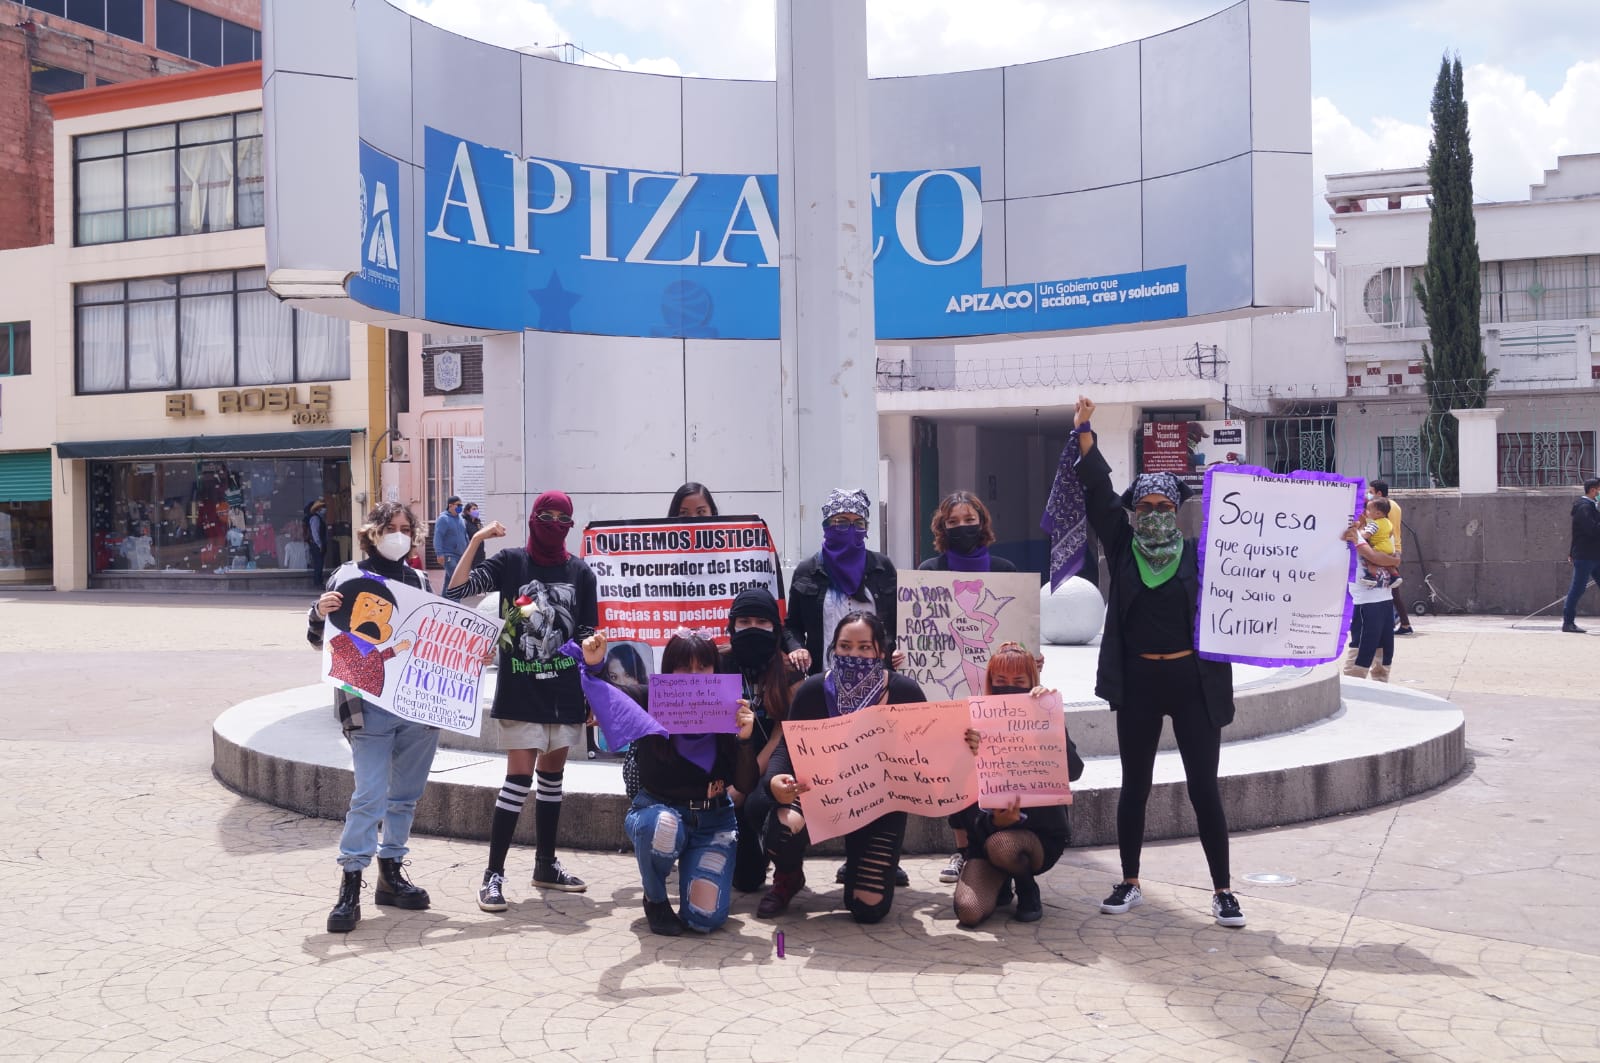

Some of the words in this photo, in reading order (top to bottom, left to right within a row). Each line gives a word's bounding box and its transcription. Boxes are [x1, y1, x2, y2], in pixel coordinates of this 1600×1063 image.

[1039, 284, 1054, 296] Un
[1055, 280, 1099, 294] Gobierno
[1100, 279, 1118, 292] que
[1041, 294, 1090, 308] acciona,
[1092, 291, 1117, 303] crea
[1119, 289, 1128, 302] y
[1128, 281, 1180, 299] soluciona
[945, 290, 1033, 313] APIZACO
[166, 393, 205, 418] EL
[218, 385, 331, 414] ROBLE
[292, 411, 330, 425] ROPA
[1219, 491, 1265, 537] Soy
[1275, 512, 1316, 531] esa
[596, 530, 691, 553] QUEREMOS
[1214, 538, 1239, 558] que
[1243, 543, 1299, 561] quisiste
[620, 559, 704, 577] Procurador
[707, 558, 731, 575] del
[1221, 557, 1267, 578] Callar
[1272, 569, 1280, 583] y
[1288, 568, 1317, 582] que
[600, 582, 641, 598] usted
[644, 580, 706, 598] también
[709, 582, 727, 597] es
[898, 586, 918, 602] CON
[920, 586, 953, 602] ROPA
[1209, 582, 1234, 603] hoy
[1282, 593, 1292, 603] a
[605, 607, 650, 622] Gracias
[653, 610, 661, 621] a
[662, 610, 677, 622] su
[912, 602, 922, 618] O
[926, 602, 950, 619] SIN
[460, 616, 497, 639] ahora
[638, 628, 661, 640] que
[905, 618, 940, 635] ROPA
[417, 616, 492, 657] GRITAMOS
[897, 634, 915, 651] MI
[917, 633, 955, 651] CUERPO
[413, 639, 484, 677] CANTAMOS
[907, 651, 927, 667] NO
[931, 651, 947, 668] SE
[964, 647, 985, 655] PARA
[973, 655, 987, 663] MI
[414, 659, 429, 671] en
[431, 663, 464, 681] forma
[465, 674, 475, 685] de
[511, 657, 543, 674] Attack
[553, 656, 576, 671] Titan
[405, 665, 475, 704] PROTESTA
[689, 677, 700, 685] de
[397, 705, 409, 715] nos
[411, 707, 426, 719] dio
[428, 712, 467, 728] RESPUESTA
[969, 701, 1027, 719] Juntas
[1007, 719, 1050, 732] nunca
[796, 737, 815, 757] Ni
[821, 742, 849, 754] una
[812, 773, 834, 786] Nos
[875, 749, 930, 766] Daniela
[976, 757, 1020, 770] Juntas
[1021, 759, 1060, 769] somos
[820, 794, 844, 807] Nos
[883, 768, 908, 783] Ana
[914, 771, 951, 786] Karen
[980, 779, 1027, 796] Juntas
[922, 794, 934, 805] el
[937, 792, 969, 807] pacto
